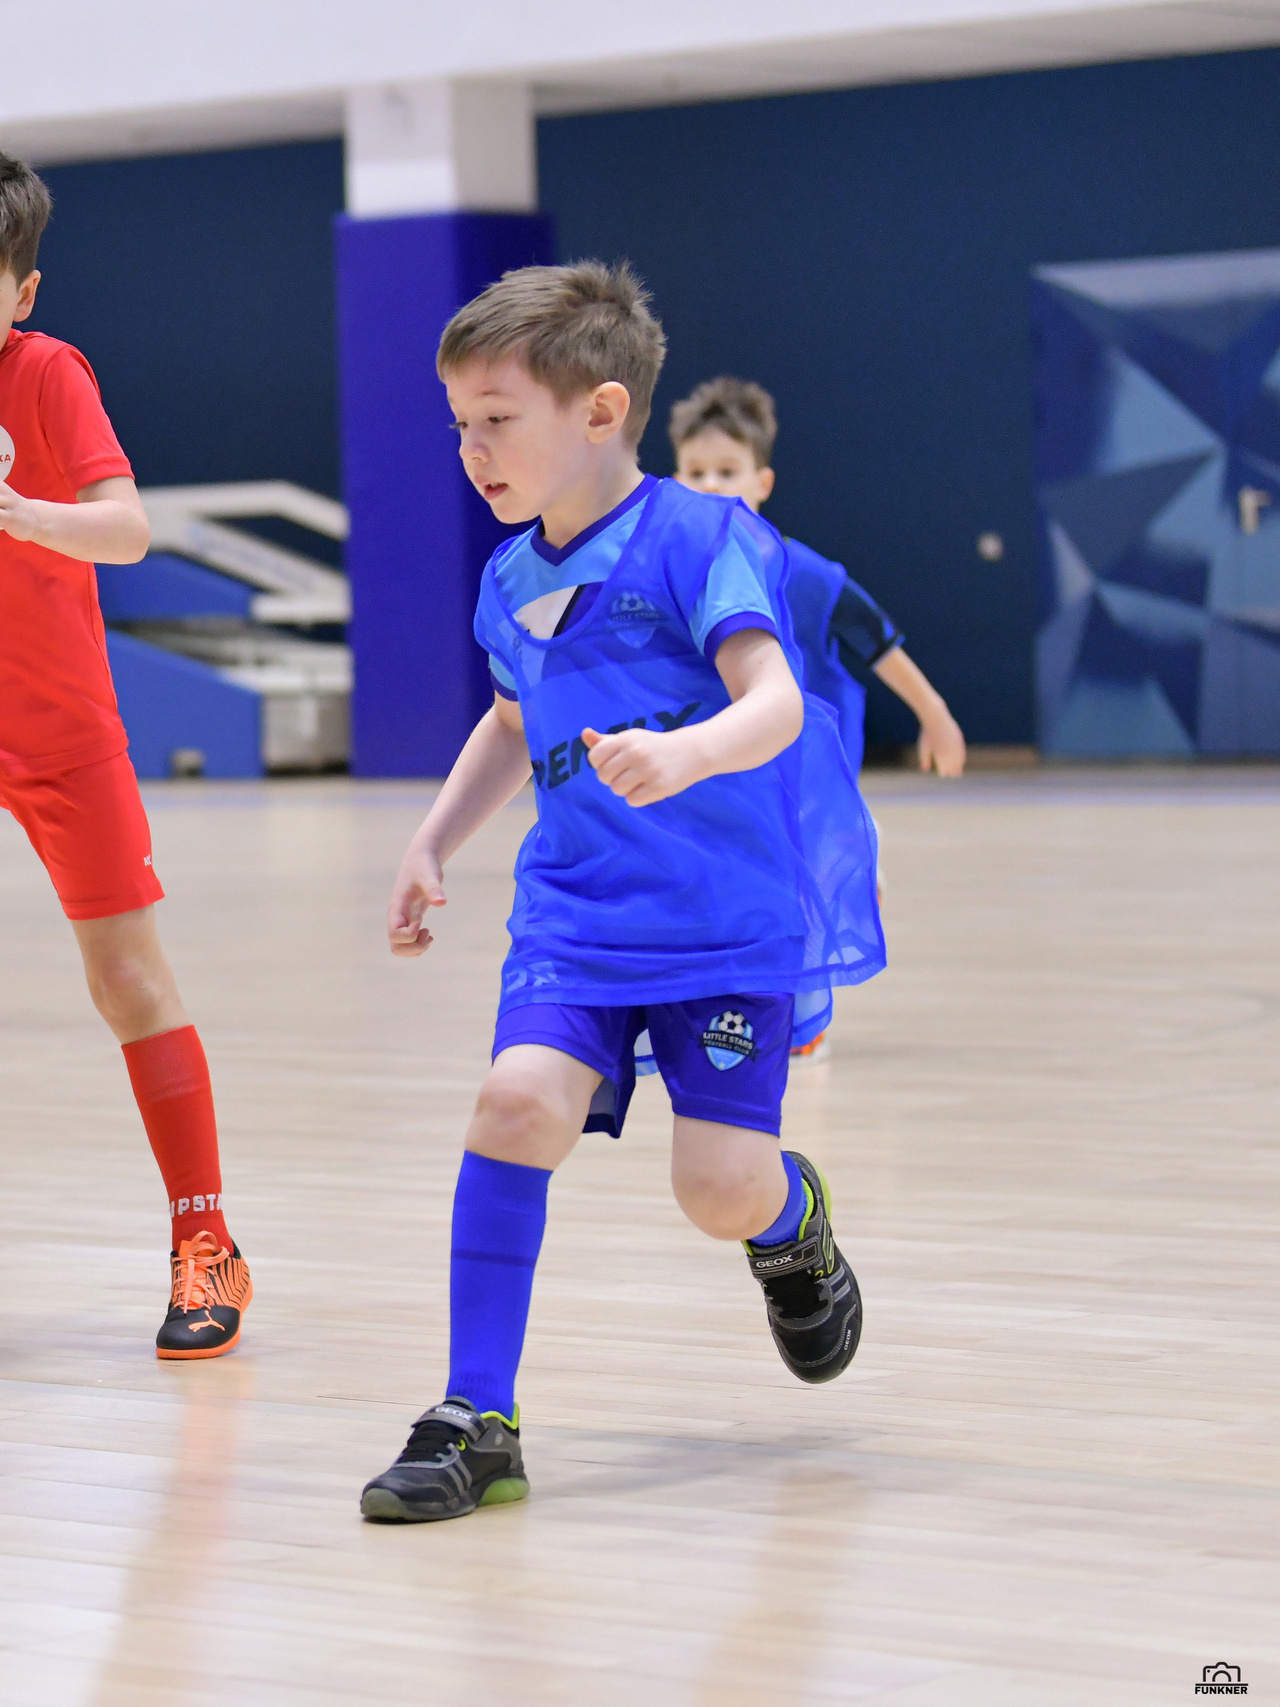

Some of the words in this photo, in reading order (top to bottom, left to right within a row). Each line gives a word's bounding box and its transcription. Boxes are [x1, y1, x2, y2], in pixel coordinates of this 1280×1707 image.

[703, 1031, 728, 1042] LITTLE
[729, 1036, 754, 1050] STARS
[756, 1254, 794, 1269] GEOX
